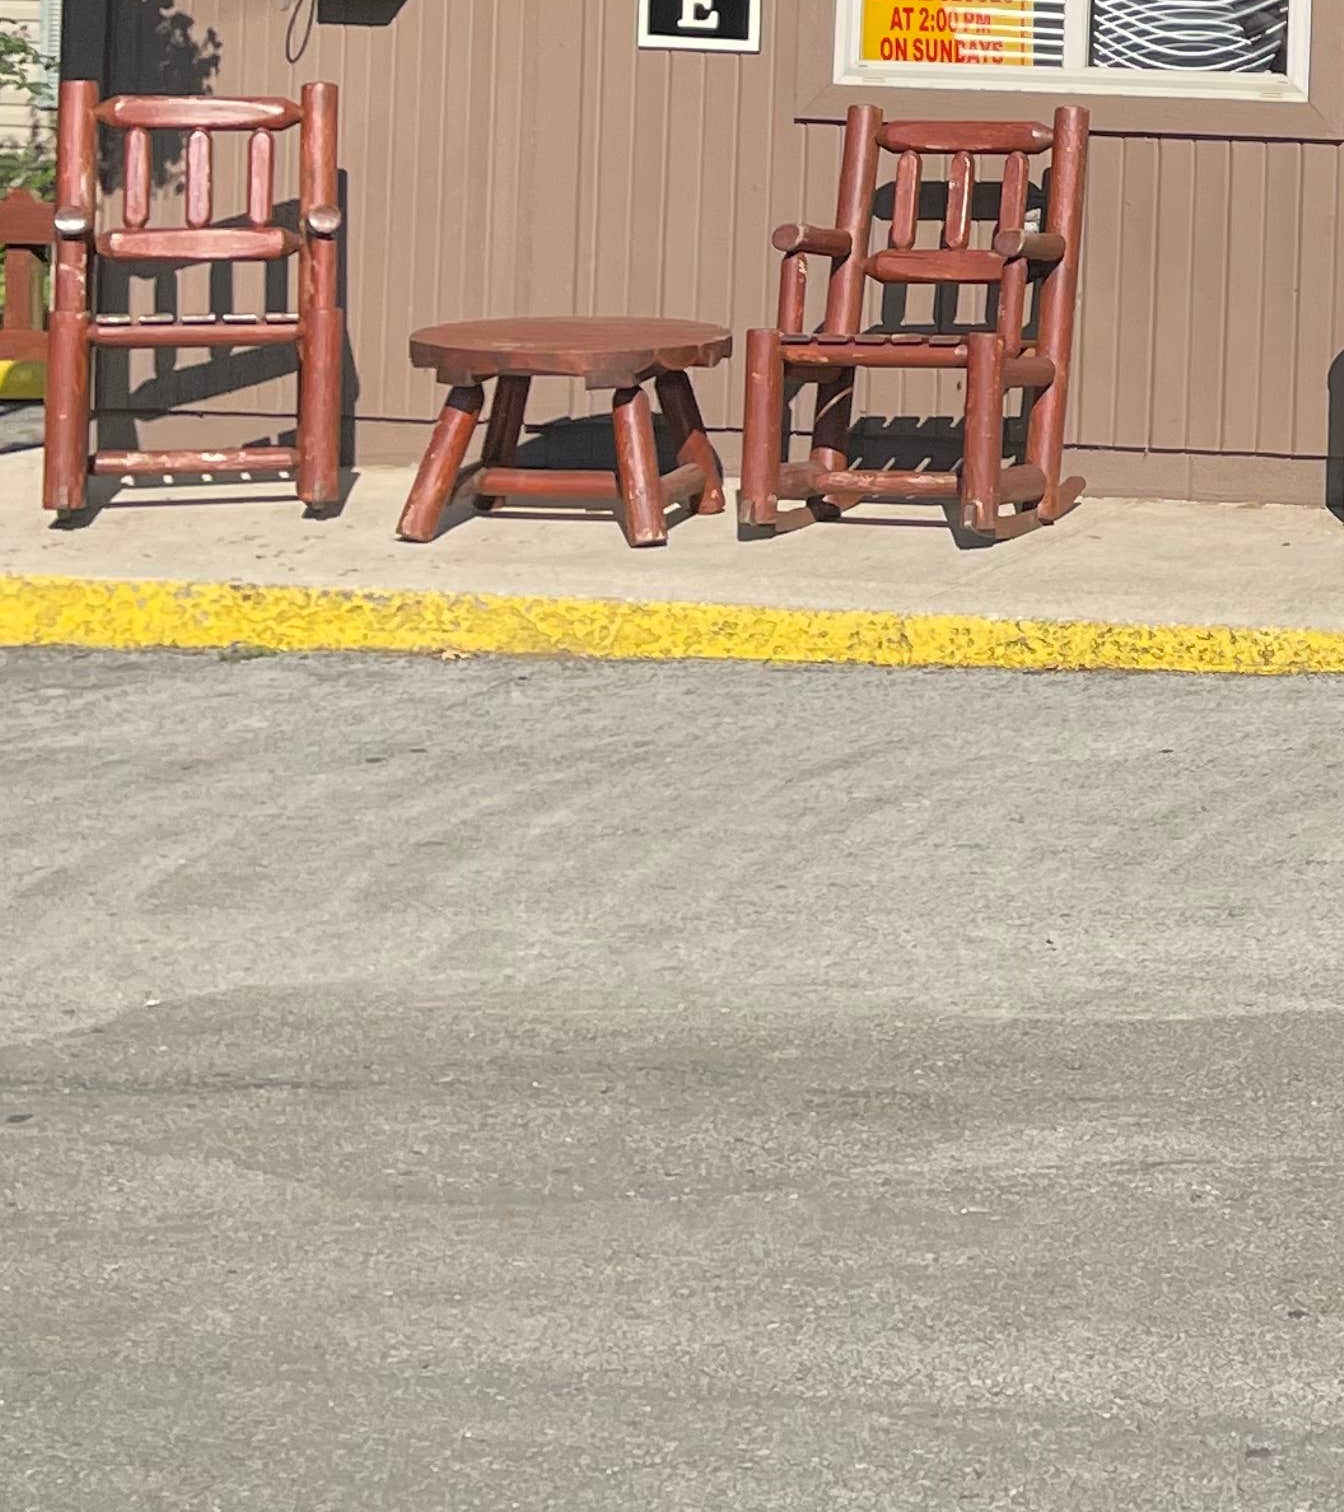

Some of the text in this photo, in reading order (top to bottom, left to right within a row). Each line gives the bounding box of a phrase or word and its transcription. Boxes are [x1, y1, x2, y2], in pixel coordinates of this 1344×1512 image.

[889, 6, 991, 35] AT 2:00 PM
[879, 36, 1004, 65] ON SUNDAYS
